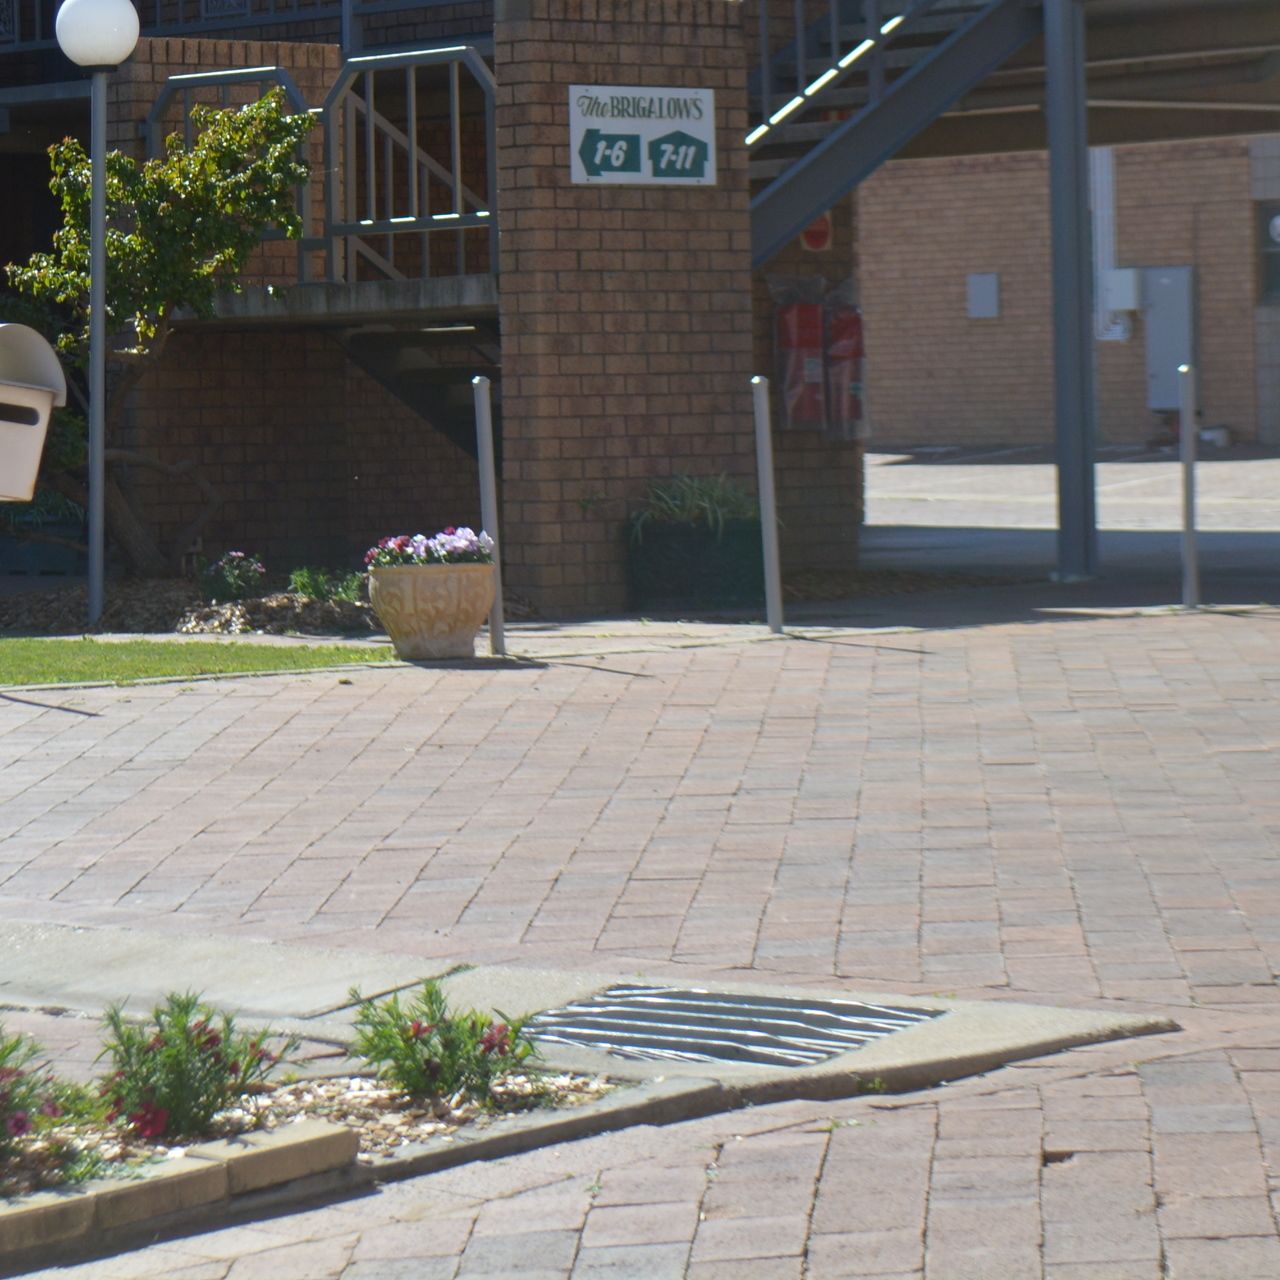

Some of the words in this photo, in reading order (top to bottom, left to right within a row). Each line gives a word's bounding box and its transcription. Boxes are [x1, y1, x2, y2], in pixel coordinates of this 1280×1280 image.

[576, 95, 609, 118] The
[610, 96, 703, 120] BRIGALOWS
[593, 140, 628, 167] 1-6
[659, 143, 697, 170] 7-11
